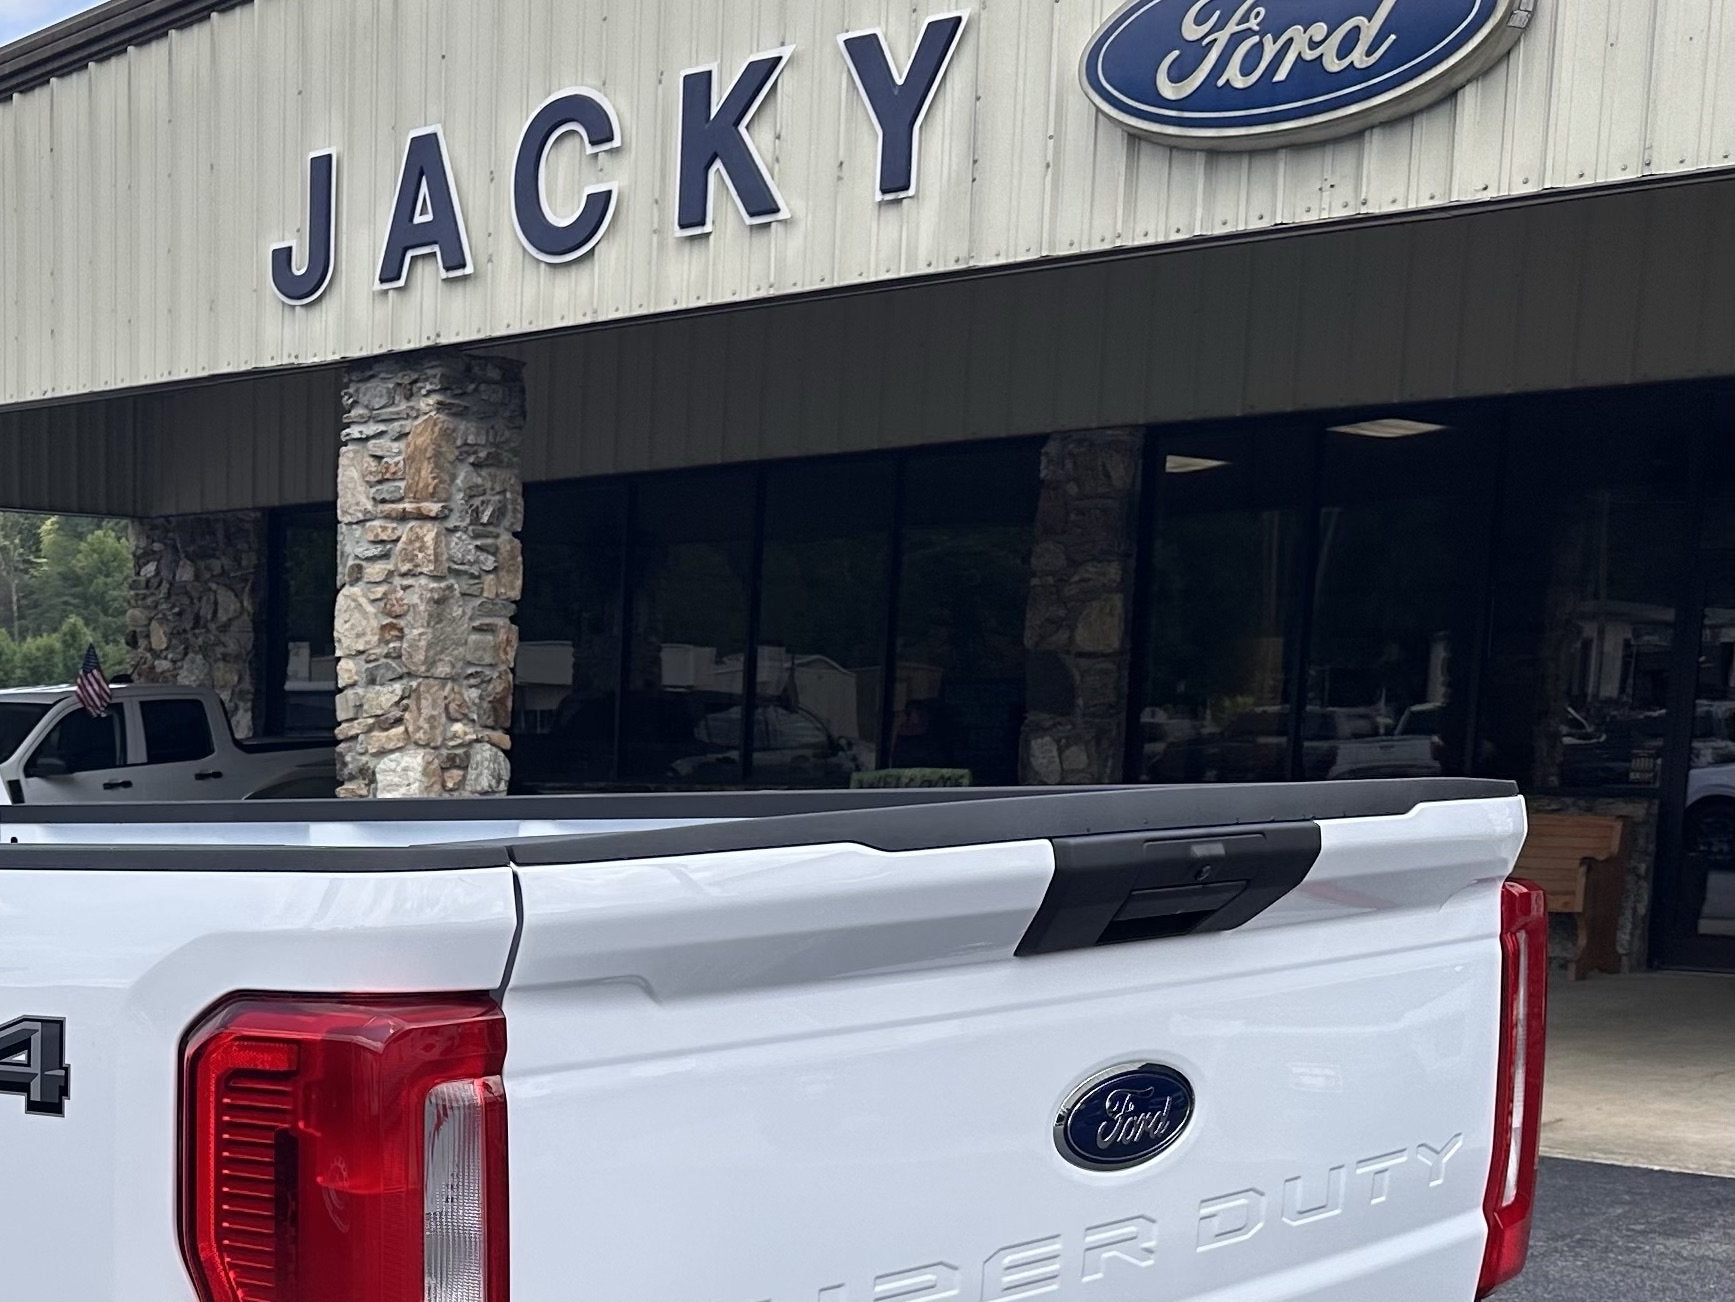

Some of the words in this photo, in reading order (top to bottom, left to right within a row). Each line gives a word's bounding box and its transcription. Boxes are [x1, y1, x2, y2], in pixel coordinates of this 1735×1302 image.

[1155, 0, 1397, 101] Ford
[269, 9, 969, 308] JACKY
[1095, 1086, 1172, 1150] Ford
[1195, 1132, 1463, 1253] DUTY
